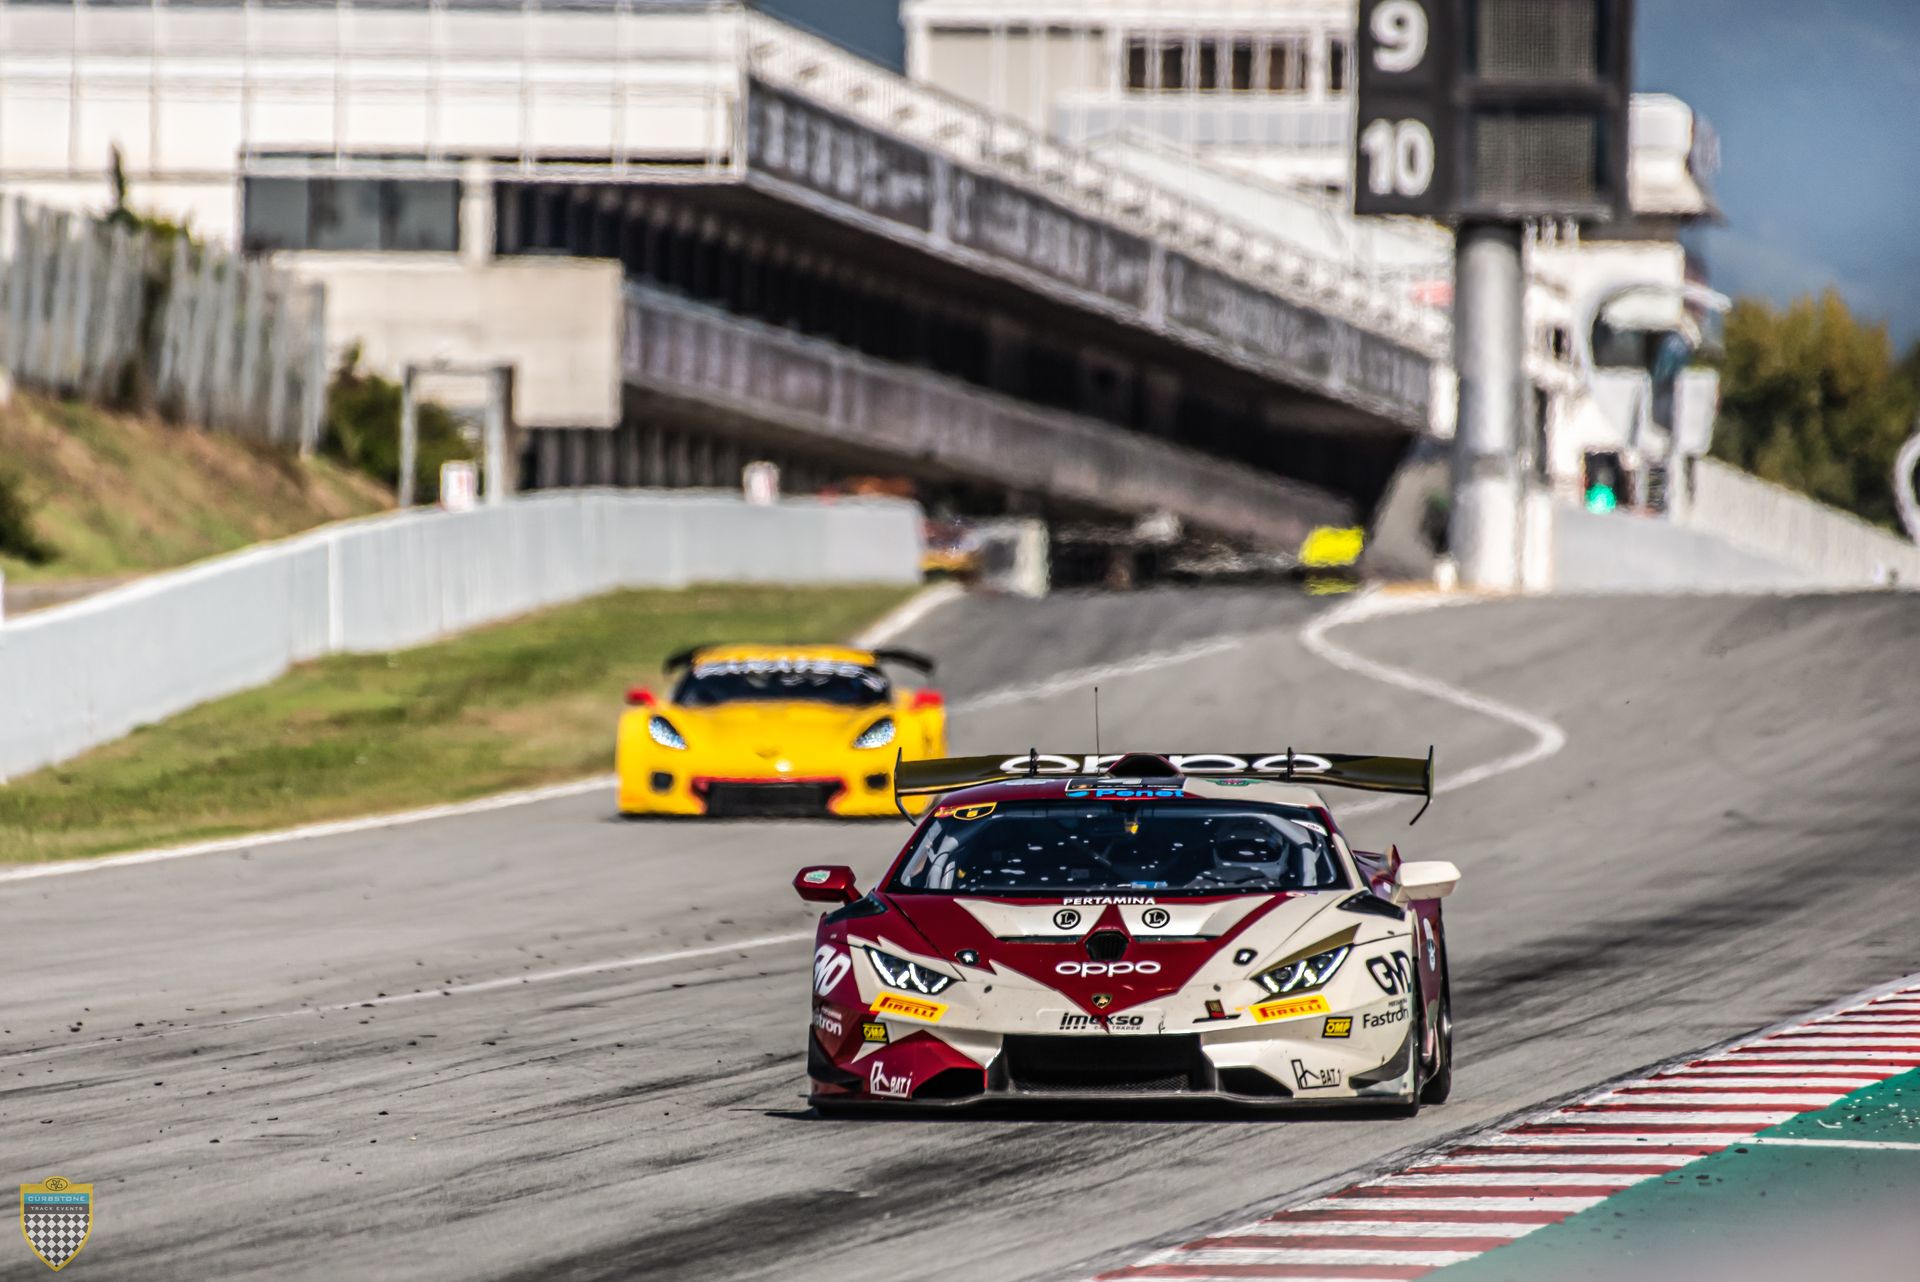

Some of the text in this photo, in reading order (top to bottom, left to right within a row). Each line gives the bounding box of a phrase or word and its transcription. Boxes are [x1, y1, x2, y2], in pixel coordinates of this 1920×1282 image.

[1370, 0, 1429, 72] 9
[1360, 118, 1435, 196] 10
[1063, 897, 1156, 906] PERTAMINA
[1055, 961, 1161, 978] oppo
[880, 997, 939, 1018] PIRELLI
[1259, 1000, 1322, 1019] PIRELLI
[1325, 1022, 1350, 1034] OMP
[1363, 1008, 1410, 1029] Fastron
